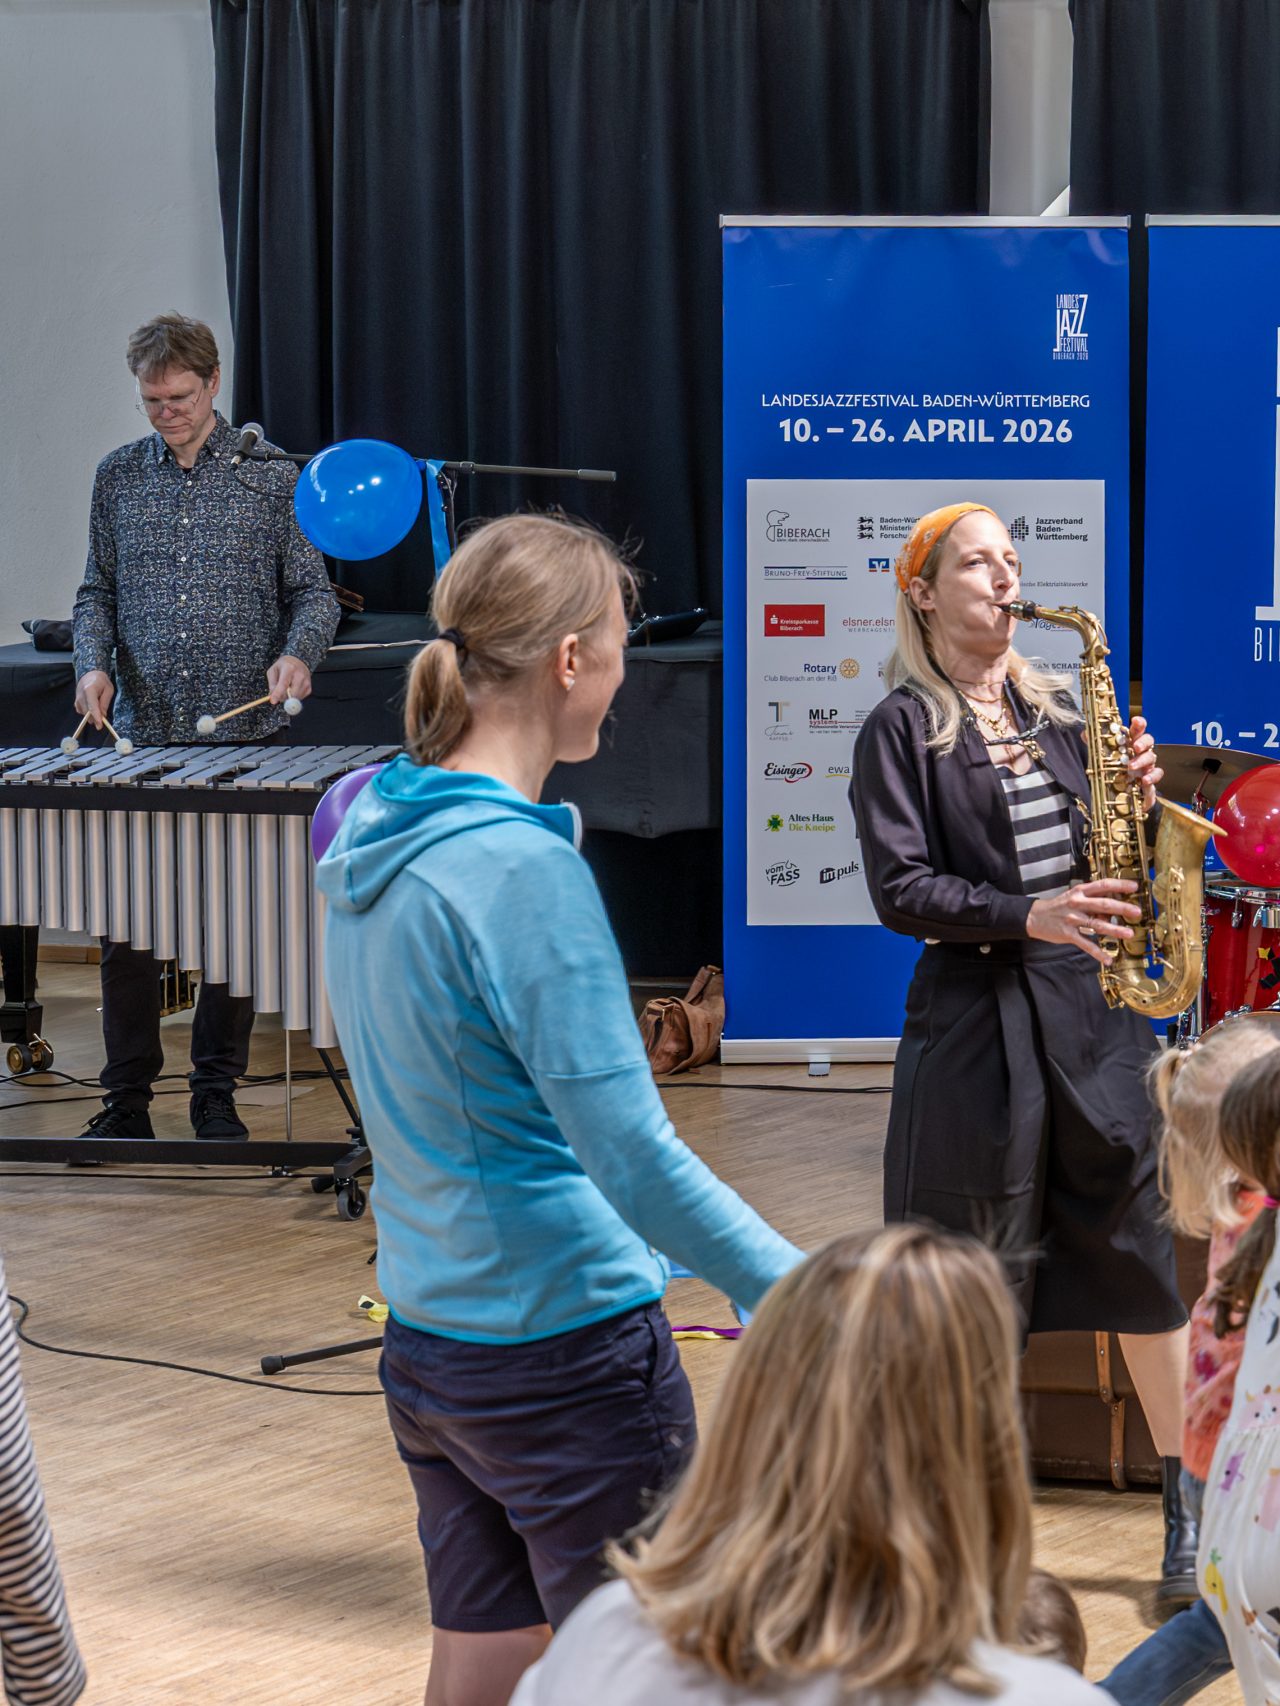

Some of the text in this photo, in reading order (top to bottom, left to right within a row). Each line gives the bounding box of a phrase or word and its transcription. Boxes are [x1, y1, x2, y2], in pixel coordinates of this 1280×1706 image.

[1056, 294, 1079, 309] LANDES
[1053, 294, 1088, 352] JAZZ
[1060, 337, 1088, 352] FESTIVAL
[762, 391, 1090, 408] LANDESJAZZFESTIVAL BADEN-WÜRTTEMBERG
[779, 418, 819, 442] 10.
[852, 418, 895, 443] 26.
[903, 418, 994, 443] APRIL
[1002, 418, 1073, 443] 2026
[1035, 517, 1083, 525] Jazzverband
[776, 528, 830, 538] BIBERACH
[1036, 533, 1088, 542] Württemberg
[803, 663, 837, 675] Rotary
[809, 709, 838, 720] MLP
[1191, 721, 1231, 747] 10.
[764, 762, 807, 778] Eisinger
[828, 766, 850, 774] ewa
[788, 814, 834, 822] Altes Haus
[789, 823, 836, 832] Die Kneipe
[765, 865, 784, 875] vom
[770, 868, 800, 885] FASS
